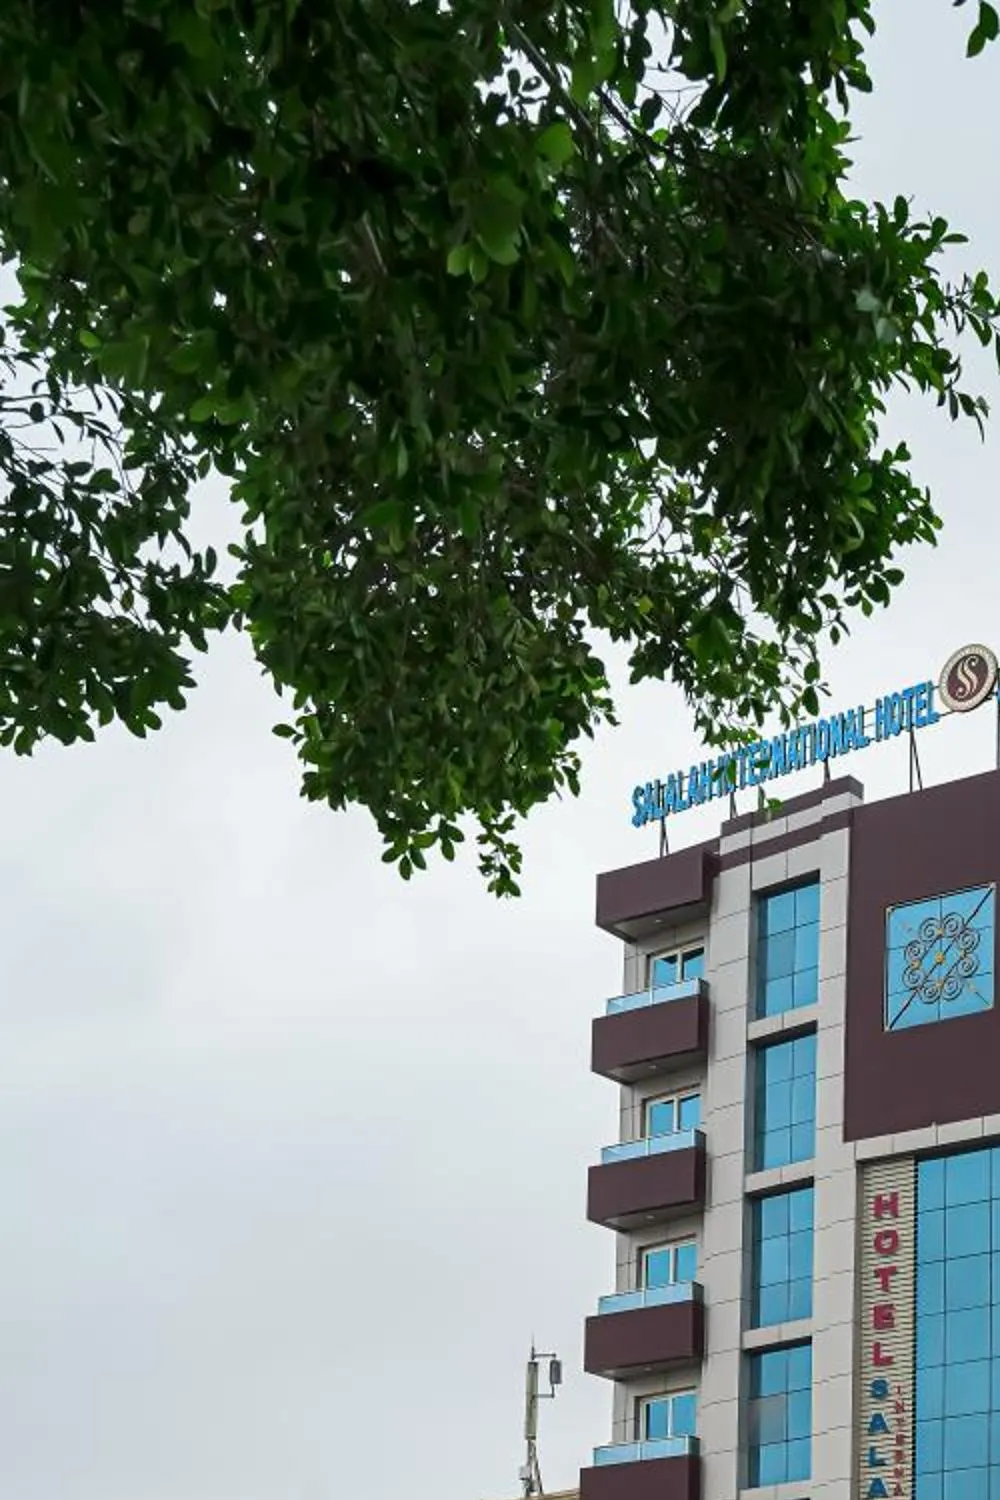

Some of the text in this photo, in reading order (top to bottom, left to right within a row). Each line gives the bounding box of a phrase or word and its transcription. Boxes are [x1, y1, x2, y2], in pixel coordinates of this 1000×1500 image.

[631, 758, 714, 828] SALALAH
[875, 680, 940, 743] HOTEL
[872, 1191, 900, 1368] HOTEL
